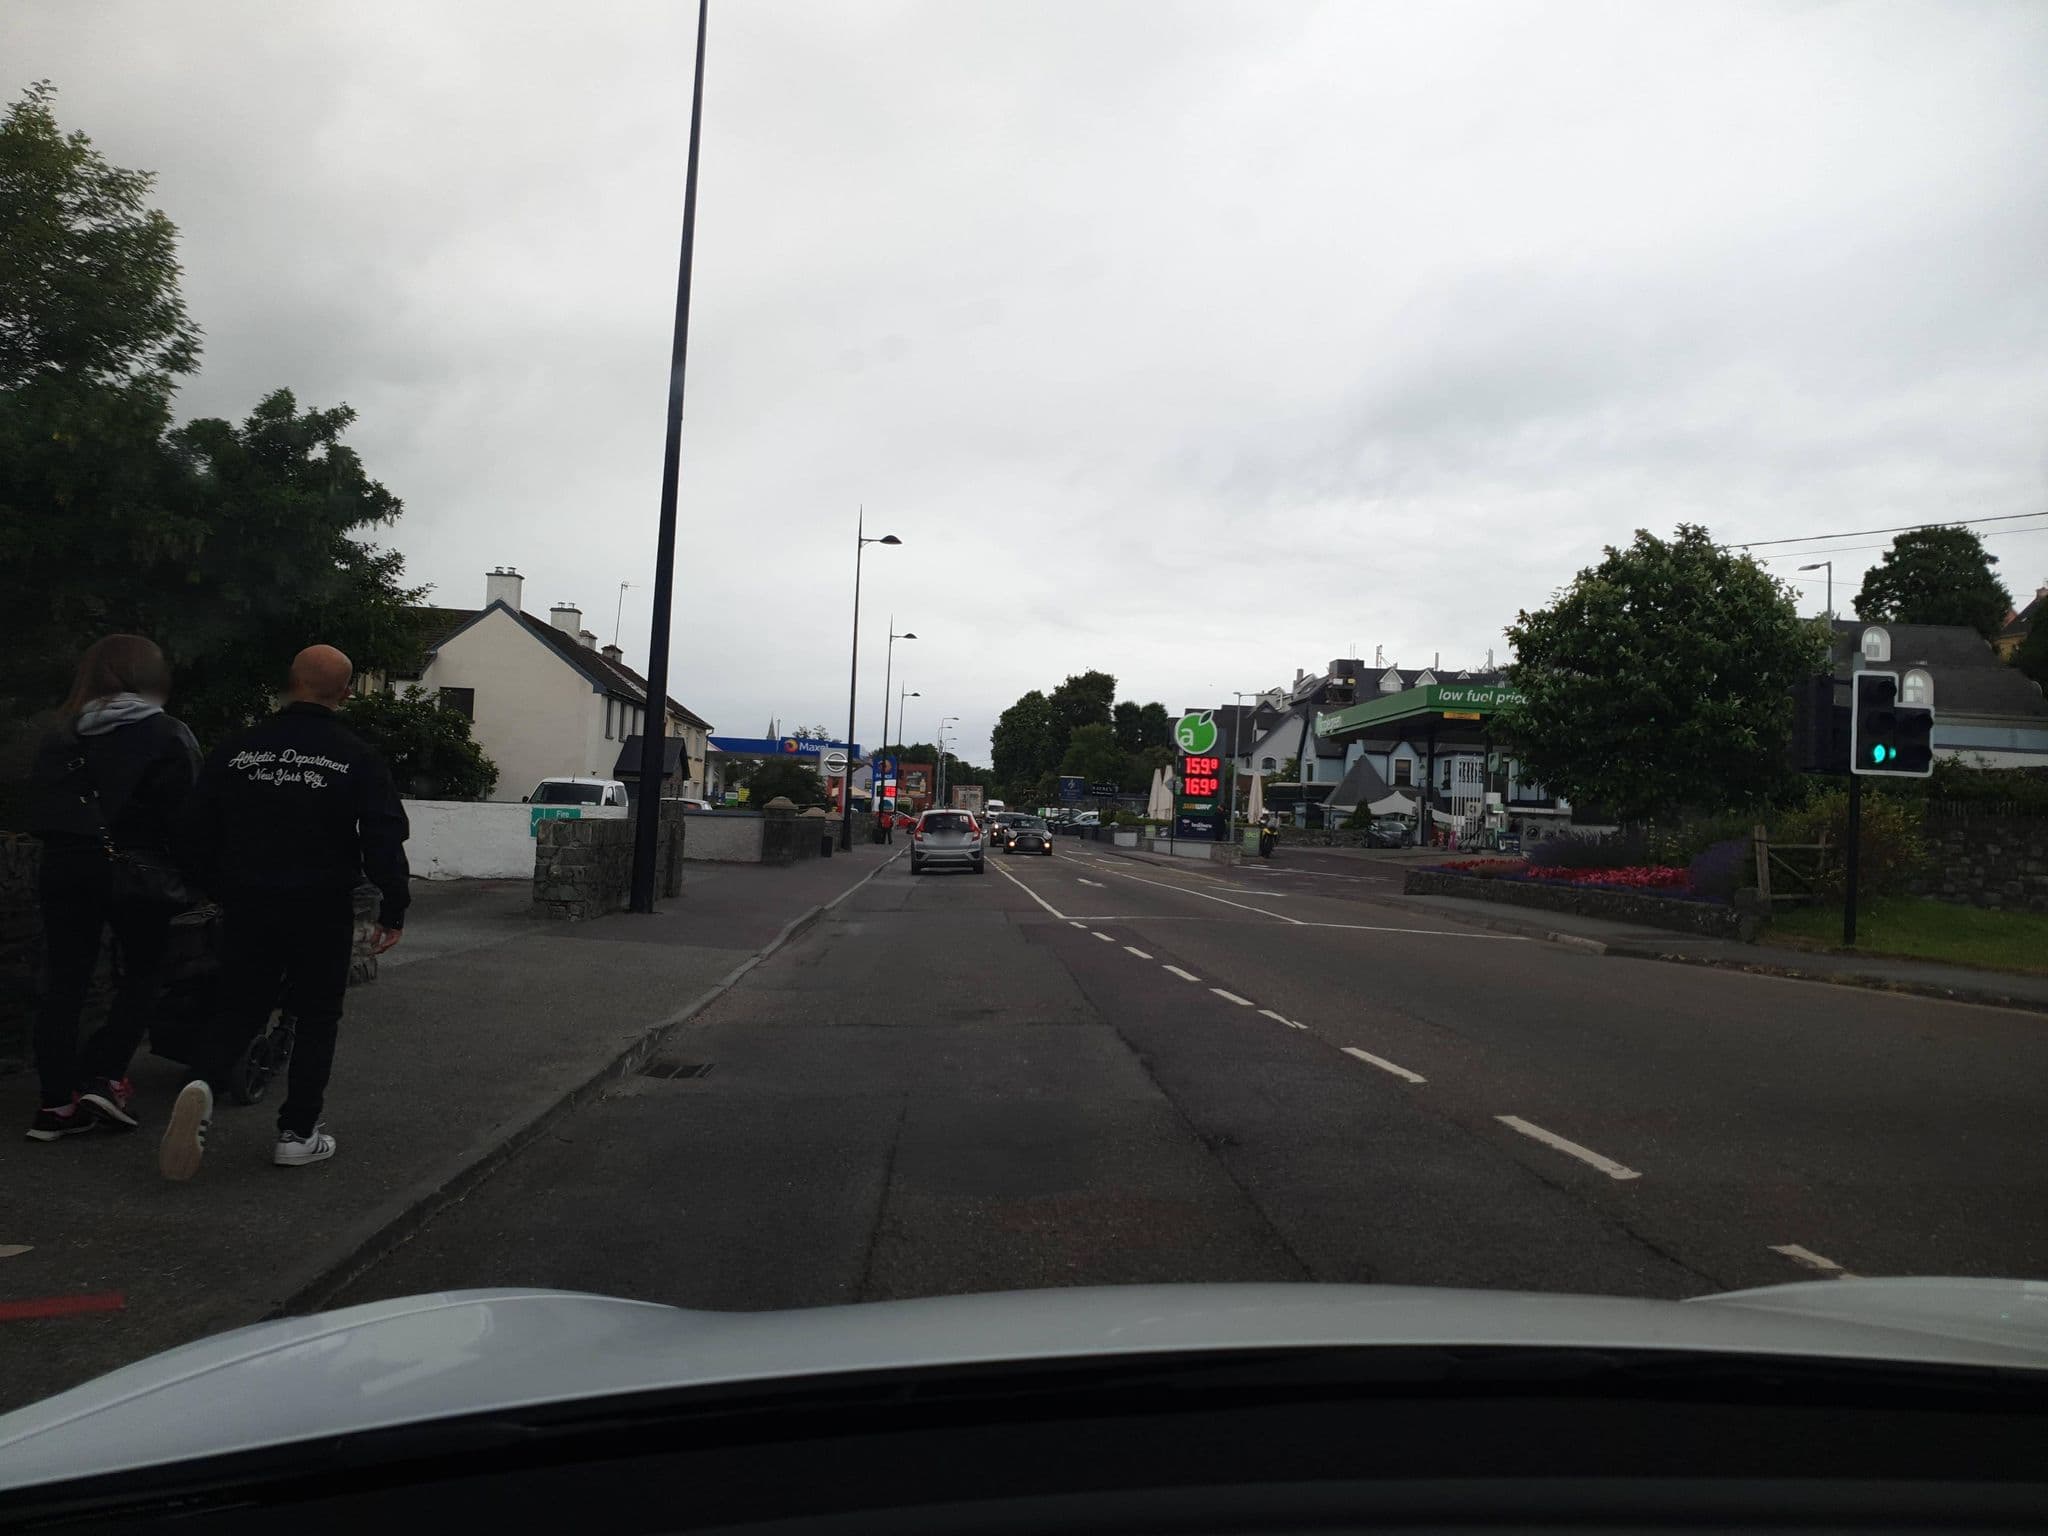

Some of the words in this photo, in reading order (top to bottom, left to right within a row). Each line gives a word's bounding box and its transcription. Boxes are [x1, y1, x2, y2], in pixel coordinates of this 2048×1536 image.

[1438, 688, 1463, 701] low
[1467, 689, 1494, 703] fuel
[229, 751, 276, 770] Athletic
[279, 748, 351, 774] Department
[248, 767, 275, 781] New
[276, 768, 301, 786] York
[303, 770, 328, 789] City
